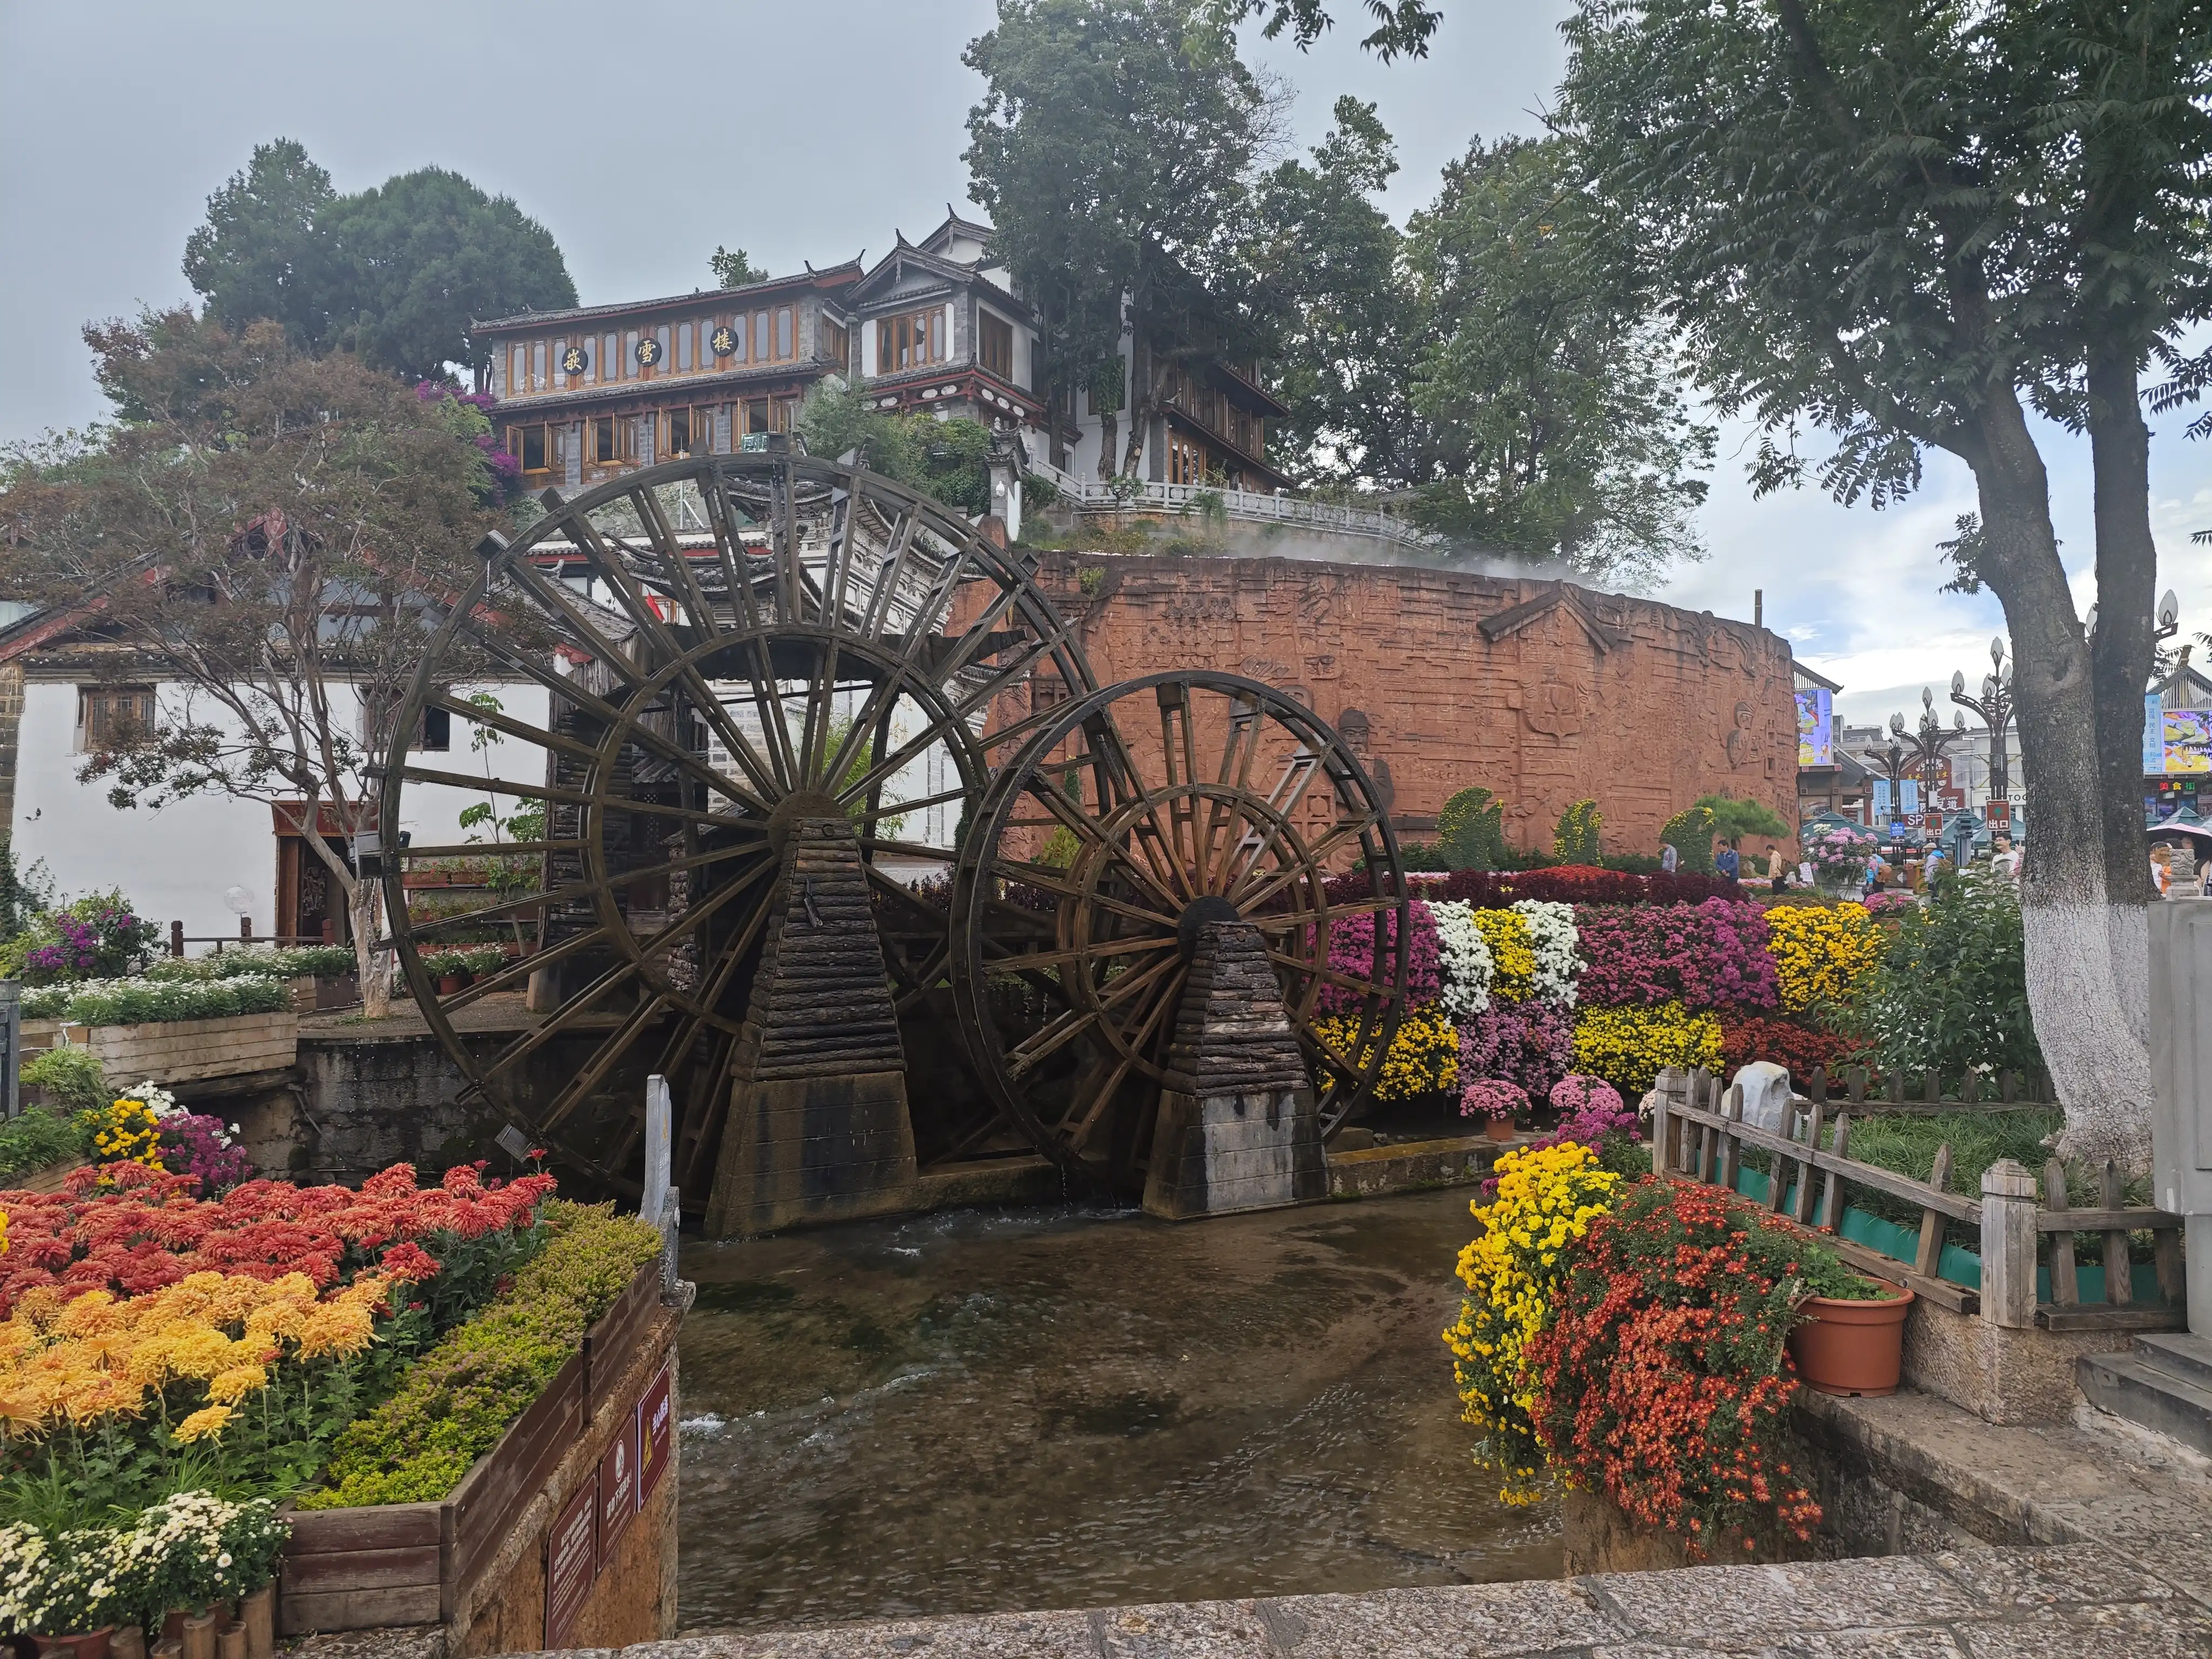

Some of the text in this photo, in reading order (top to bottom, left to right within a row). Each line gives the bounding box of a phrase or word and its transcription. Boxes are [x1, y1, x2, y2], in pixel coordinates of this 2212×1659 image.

[2149, 722, 2155, 734] 民主
[2149, 737, 2156, 748] 文明
[2159, 781, 2195, 791] 美食街
[1988, 819, 2008, 829] 出口
